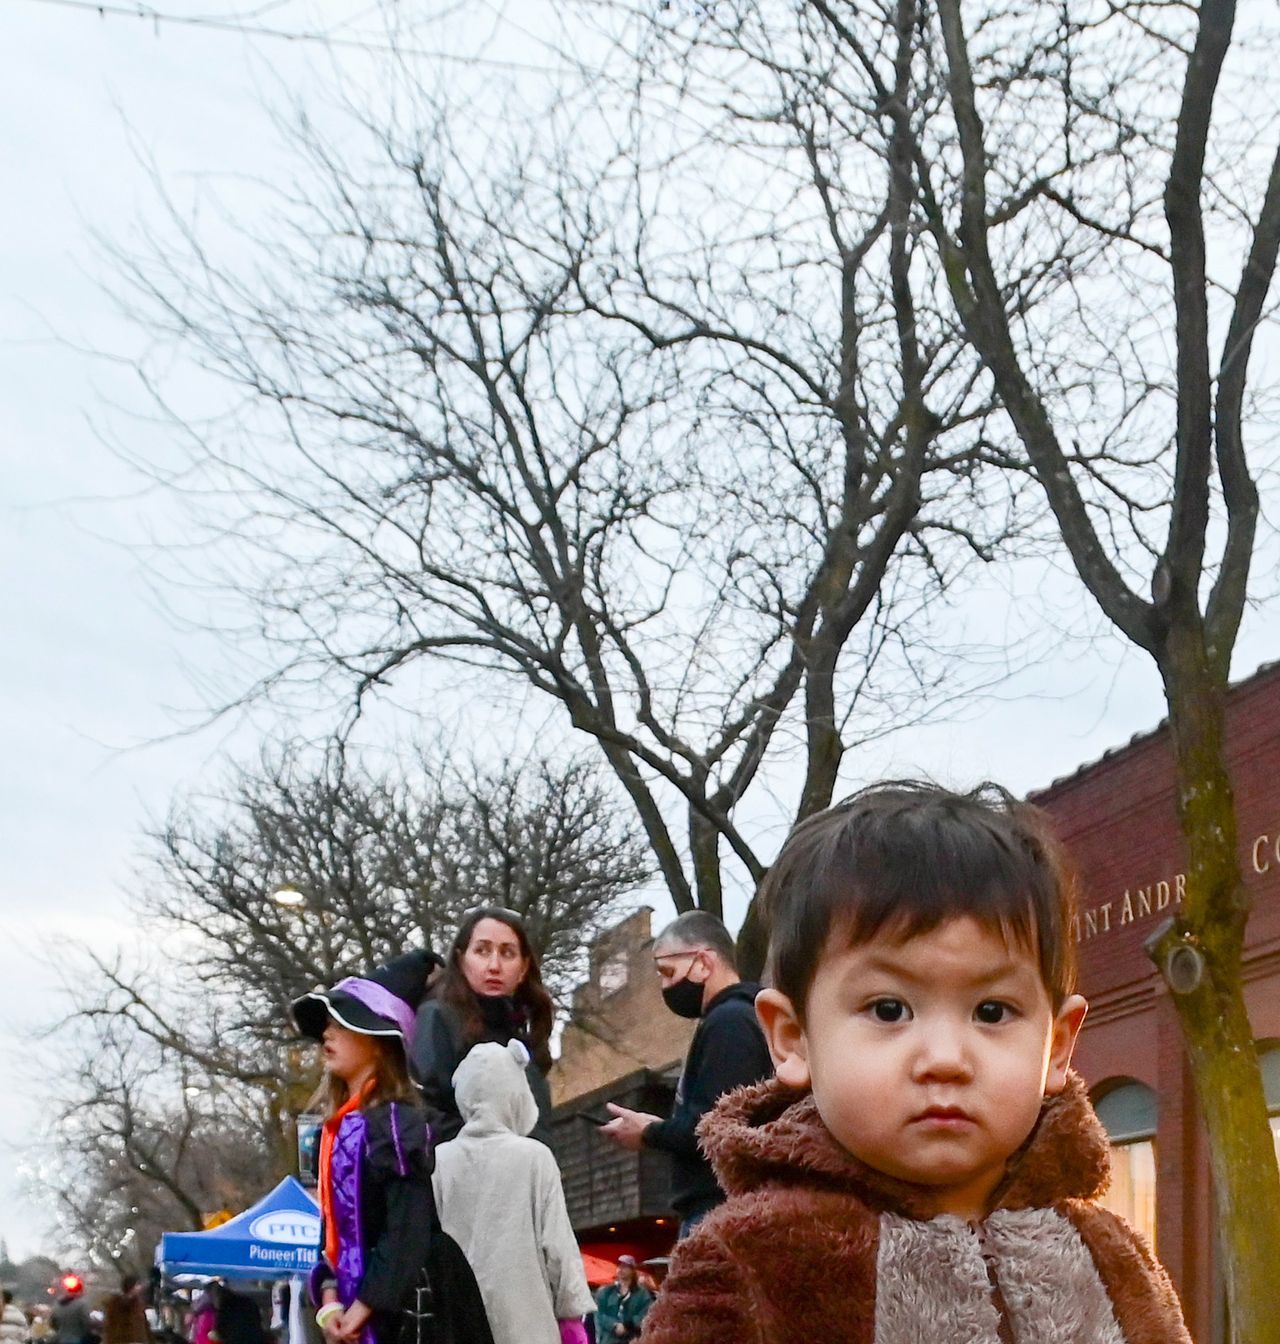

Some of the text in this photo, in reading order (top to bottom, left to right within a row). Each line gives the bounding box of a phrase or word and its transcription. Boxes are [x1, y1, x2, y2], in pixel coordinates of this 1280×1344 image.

[1074, 902, 1113, 943] INT
[1120, 873, 1186, 926] ANDR
[269, 1223, 318, 1239] PTC
